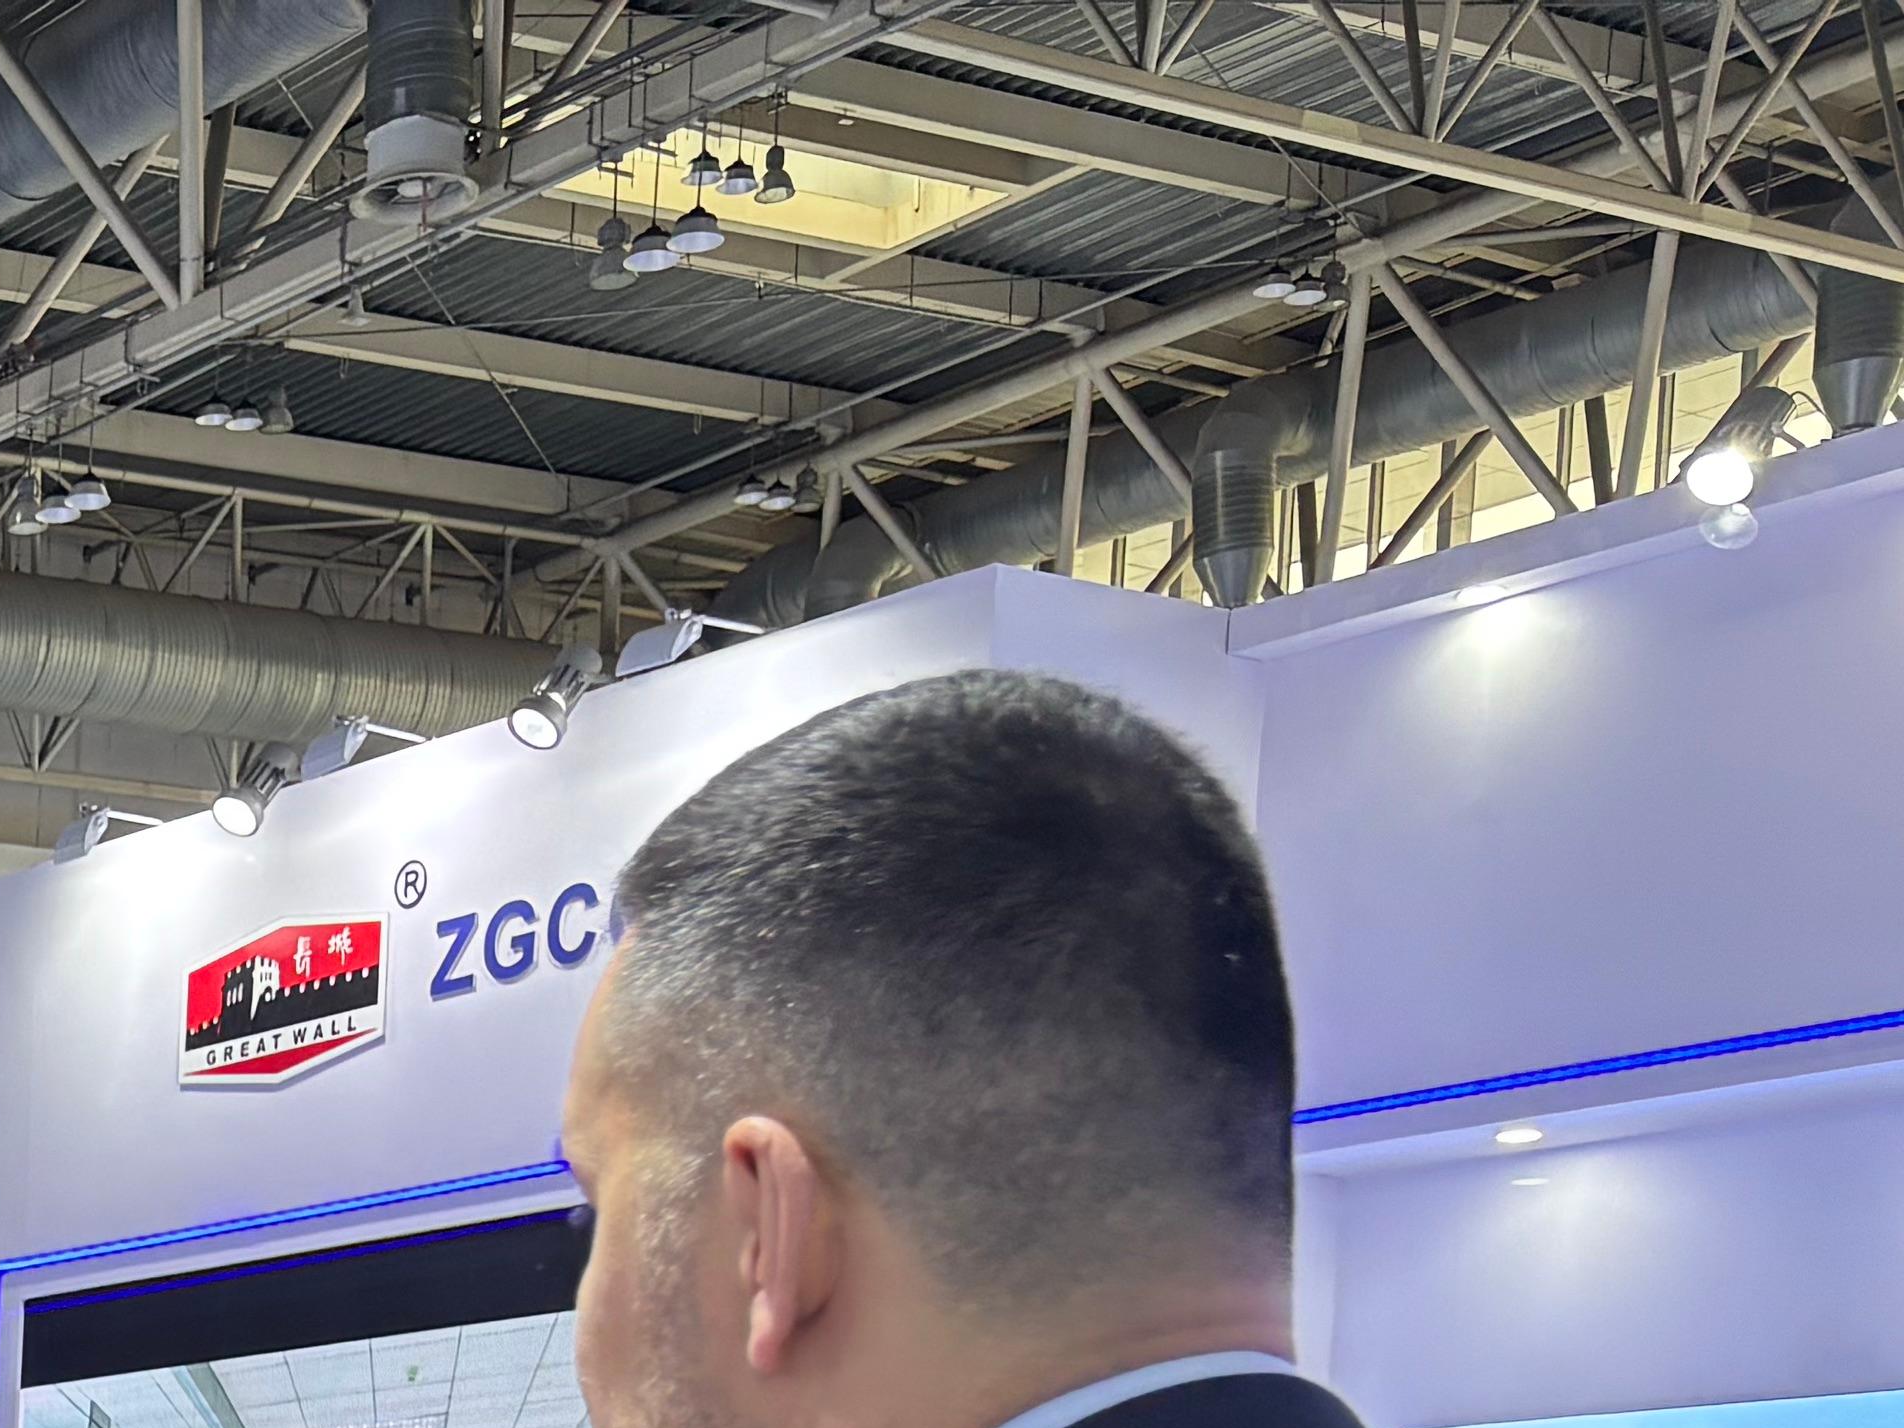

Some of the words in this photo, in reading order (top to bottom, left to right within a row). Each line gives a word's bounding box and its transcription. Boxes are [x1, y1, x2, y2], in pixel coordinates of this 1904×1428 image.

[430, 881, 624, 1002] ZGC
[206, 1033, 281, 1067] GREAT
[292, 1015, 358, 1045] WALL
